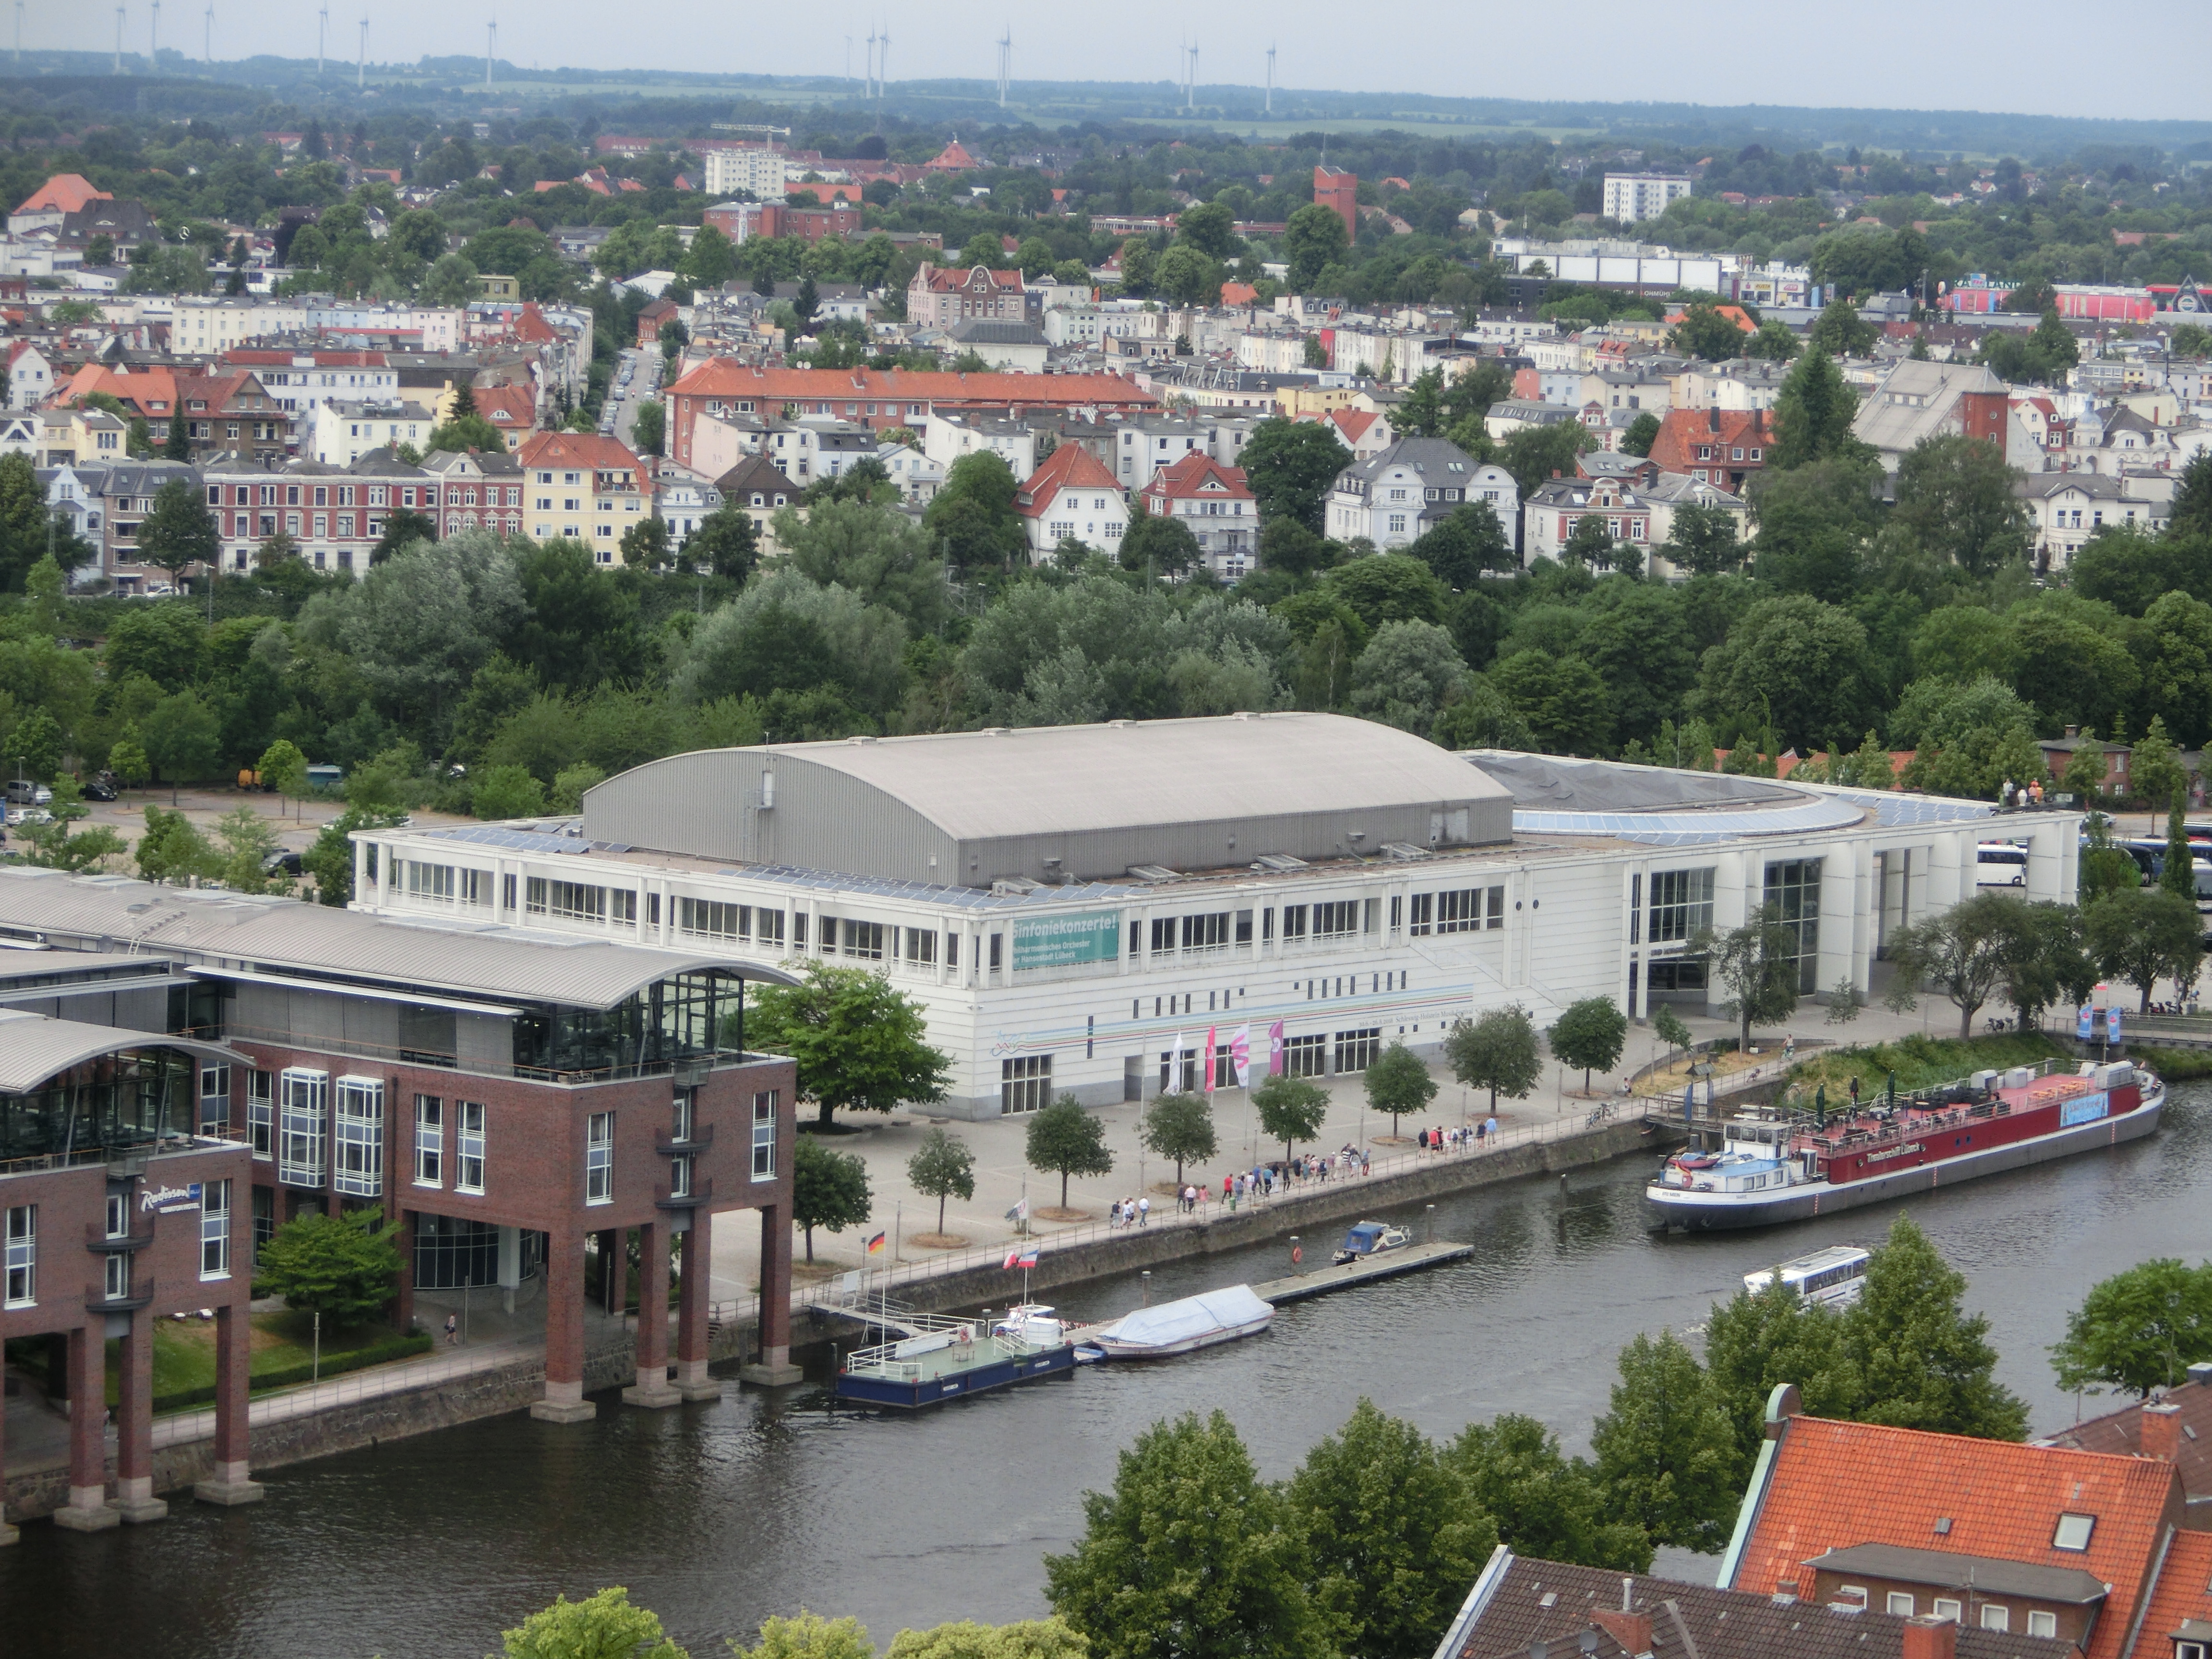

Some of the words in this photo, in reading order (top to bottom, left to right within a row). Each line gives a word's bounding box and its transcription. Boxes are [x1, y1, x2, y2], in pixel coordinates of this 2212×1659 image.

[1063, 940, 1091, 949] Orchester
[1021, 953, 1054, 963] Hansestadt
[1055, 950, 1076, 959] Lübeck
[1396, 1012, 1440, 1023] Schleswig-Holstein
[1866, 1145, 1901, 1163] Theaterschiff
[1900, 1142, 1920, 1155] Lübeck
[141, 1185, 190, 1212] Radisson
